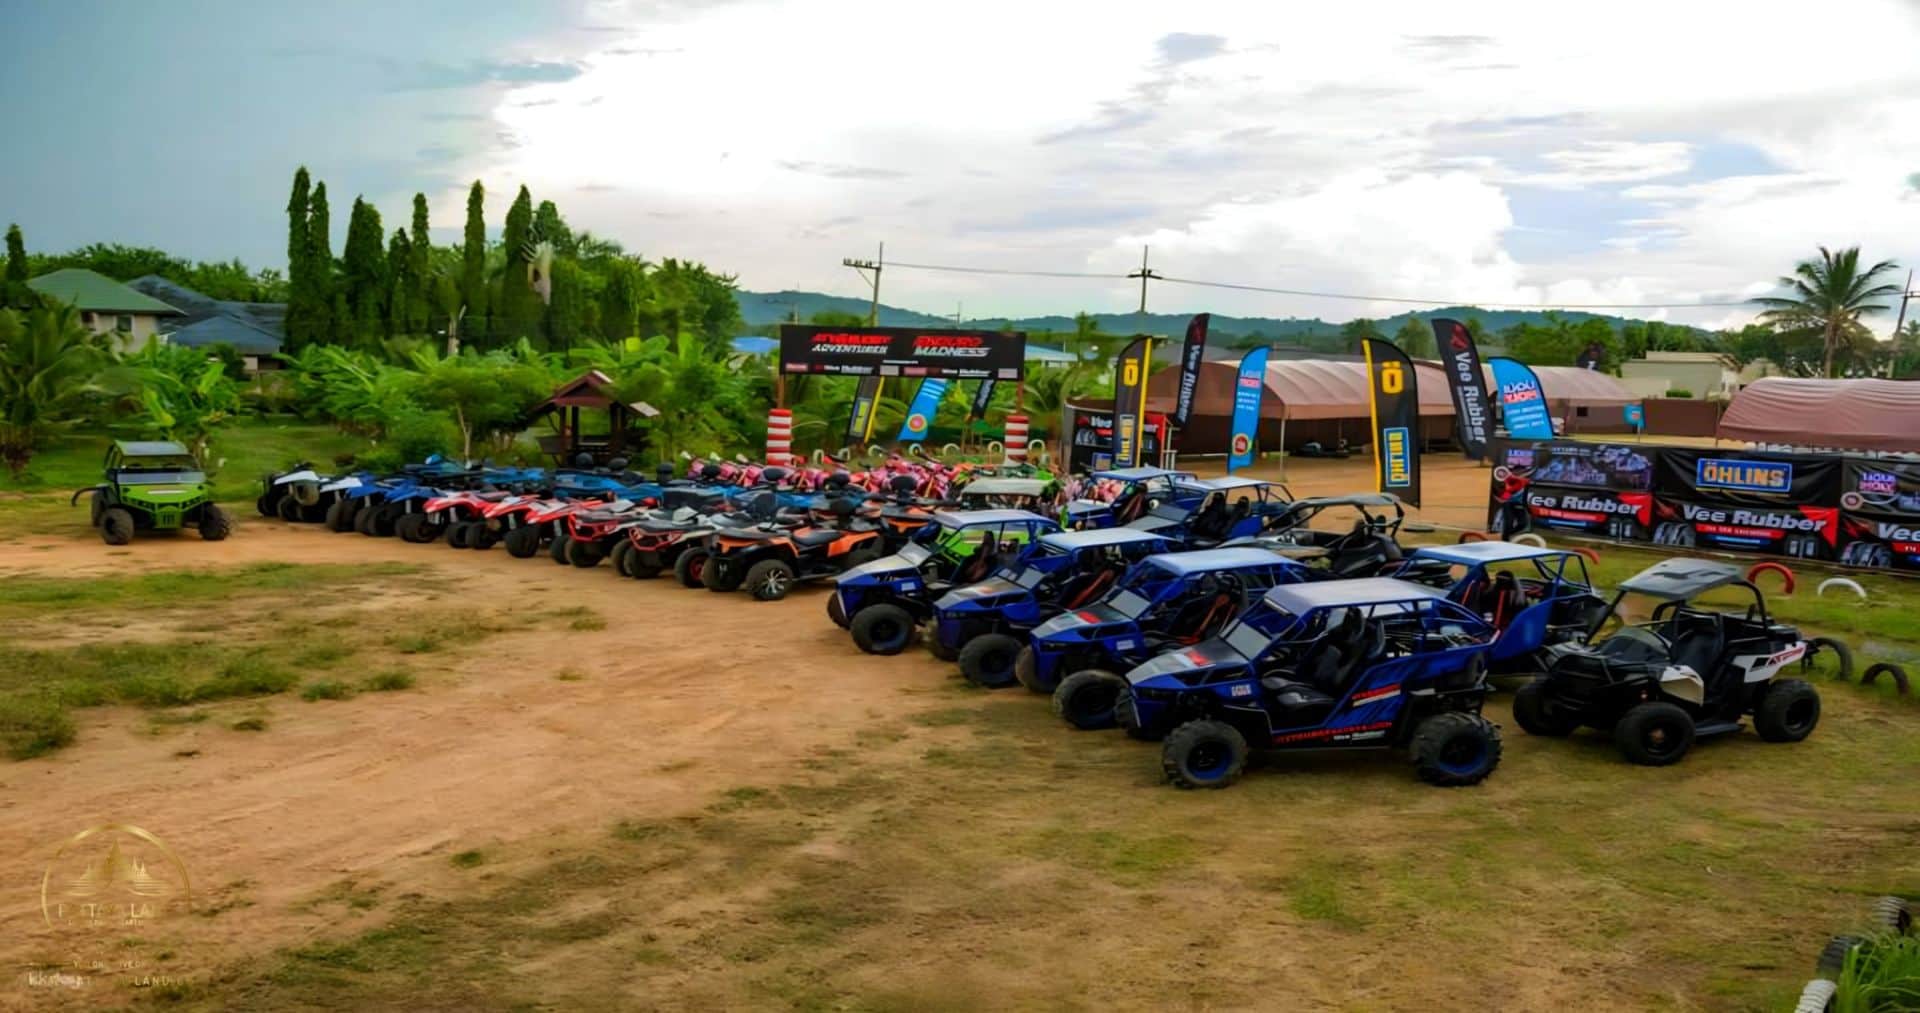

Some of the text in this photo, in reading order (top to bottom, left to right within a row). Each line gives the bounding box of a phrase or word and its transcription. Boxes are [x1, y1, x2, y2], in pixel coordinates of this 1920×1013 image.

[913, 346, 992, 357] MADNESS
[1455, 352, 1472, 382] Vee
[1463, 386, 1487, 444] Rubber
[1703, 461, 1785, 488] ÖHLINS
[1561, 495, 1643, 514] Rubber
[1682, 503, 1726, 523] Vee
[1732, 509, 1827, 532] Rubber
